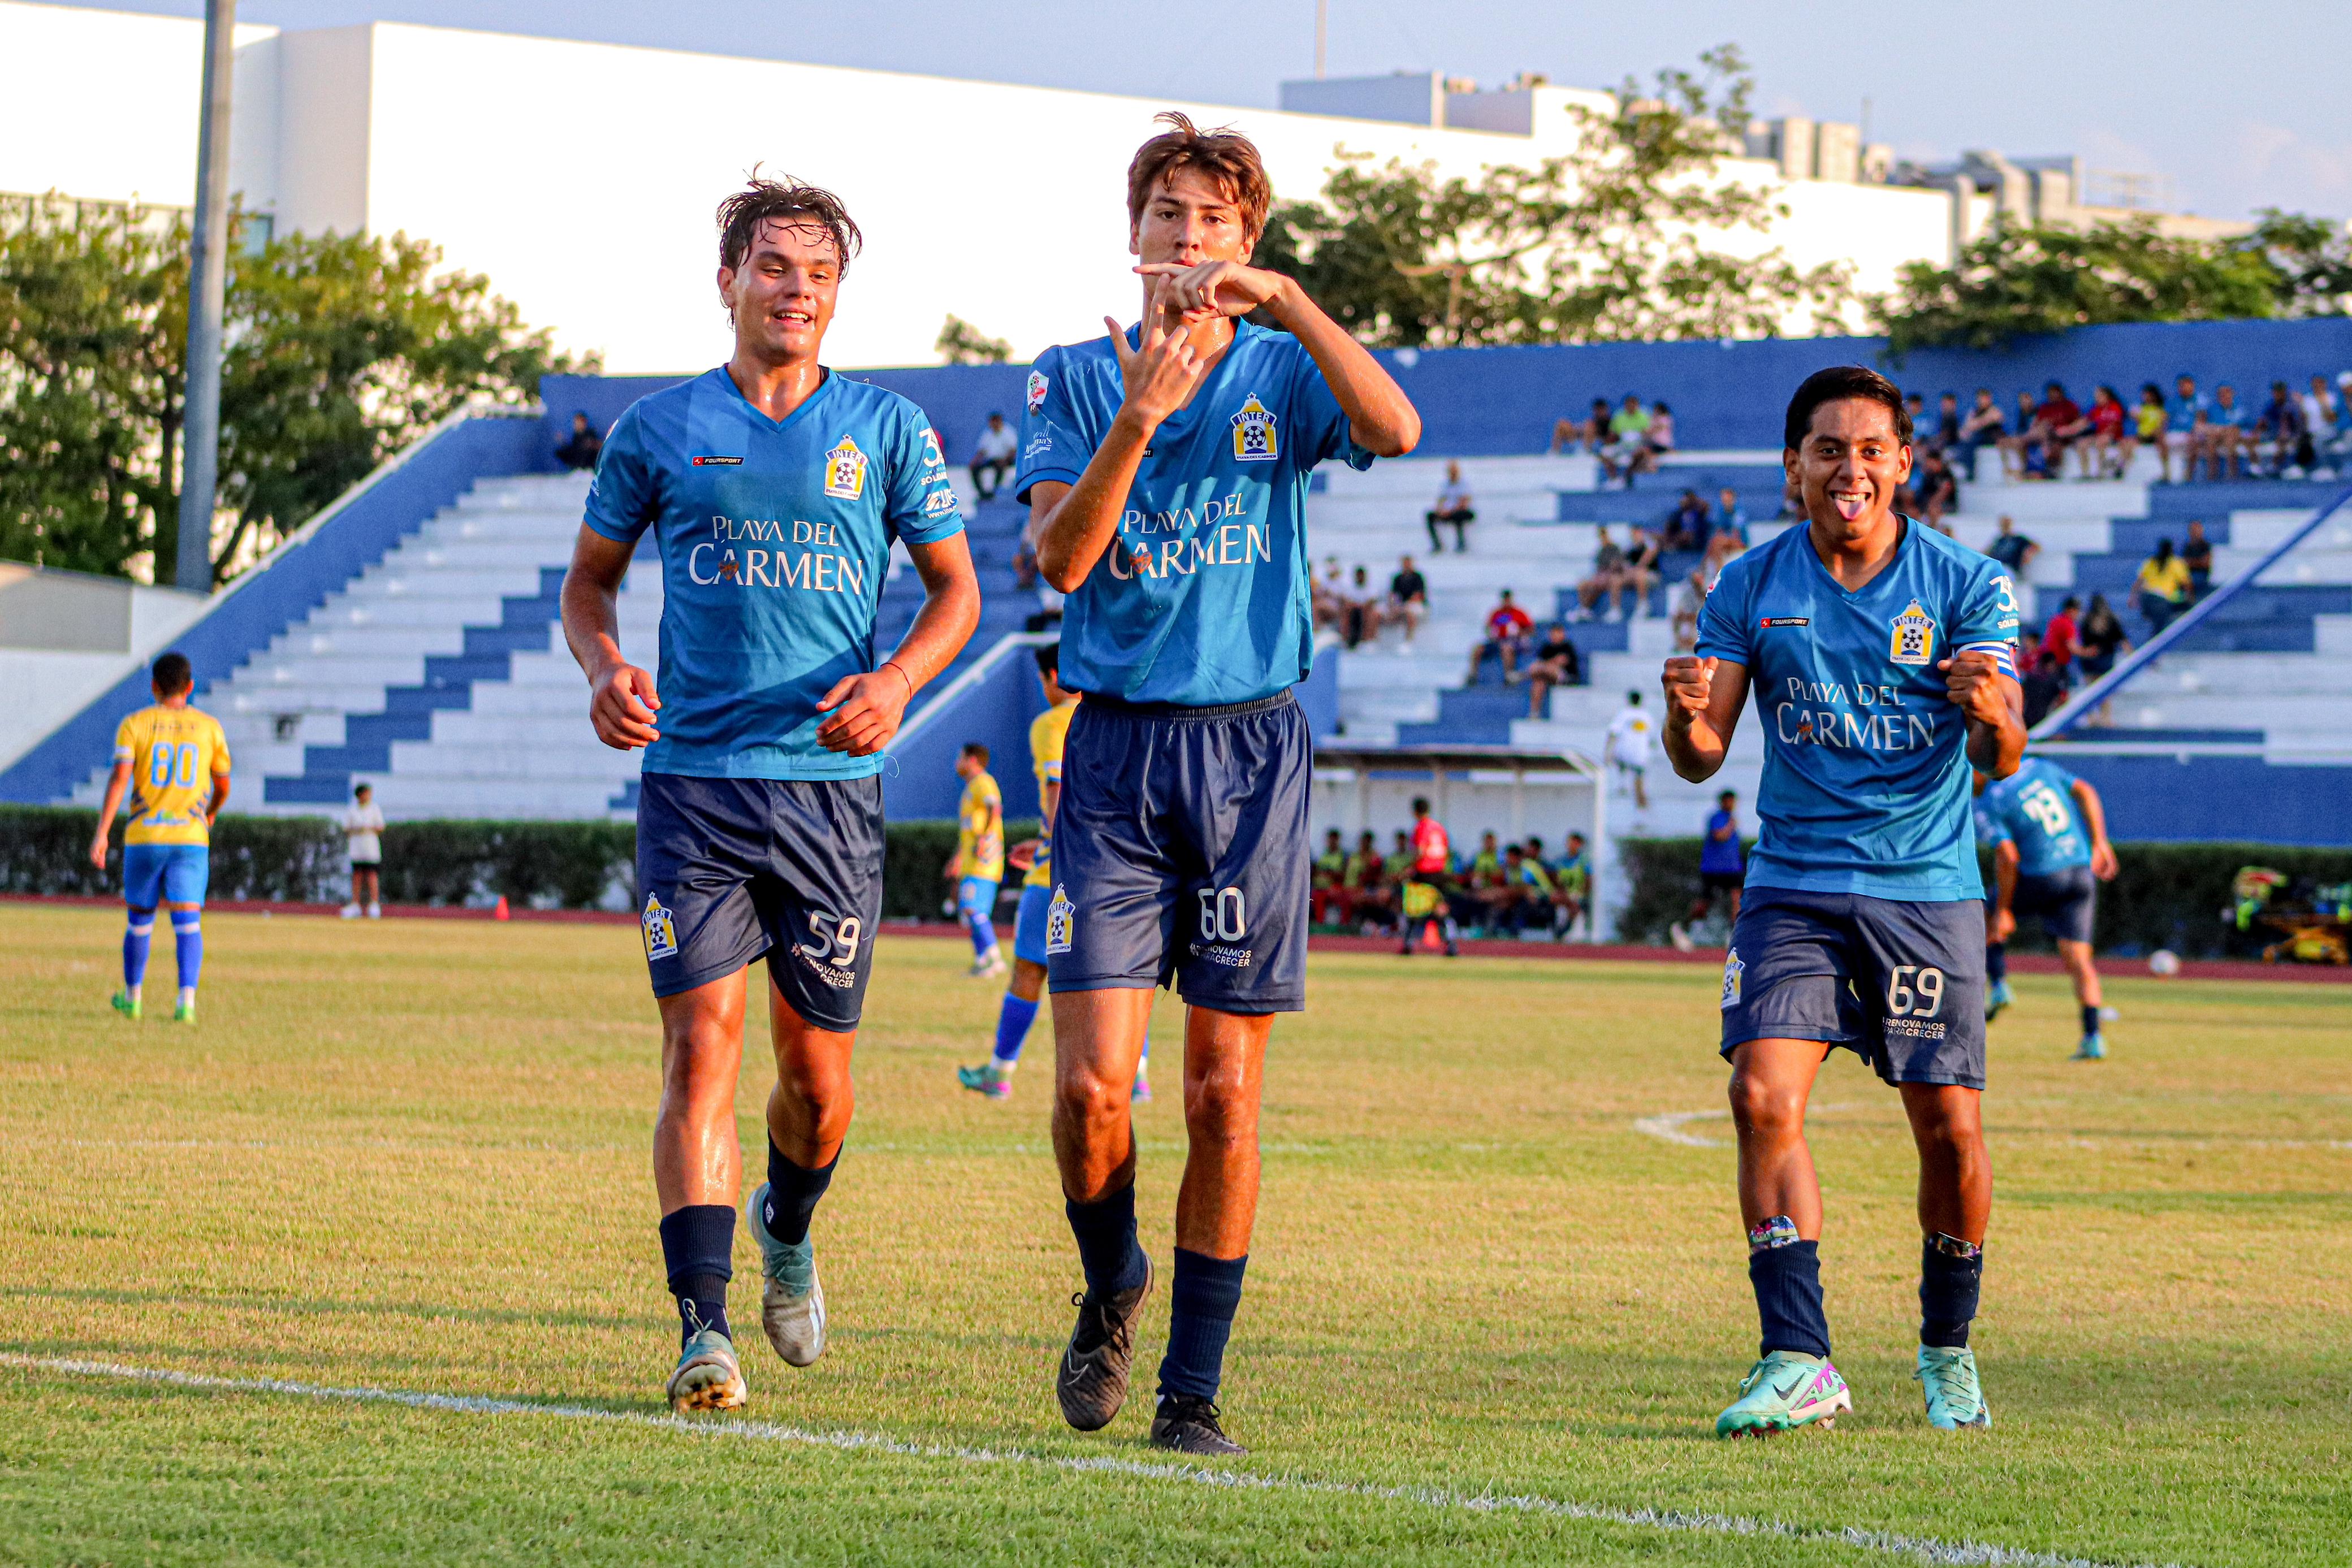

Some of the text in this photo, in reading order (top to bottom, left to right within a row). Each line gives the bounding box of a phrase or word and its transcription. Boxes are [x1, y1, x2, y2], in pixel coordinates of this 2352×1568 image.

[1237, 412, 1270, 423] INTER
[832, 450, 862, 464] INTER
[712, 516, 840, 546] PLAYA DEL
[1124, 492, 1247, 534] PLAYA DEL
[689, 542, 863, 595] CARMEN
[1109, 523, 1271, 581] CARMEN
[1899, 616, 1929, 627] INTER
[1787, 677, 1906, 706] PLAYA DEL
[1777, 701, 1935, 751] CARMEN
[150, 742, 198, 787] 80
[645, 909, 665, 921] INTER
[1050, 902, 1070, 914] INTER
[1197, 886, 1245, 941] 60
[800, 909, 861, 966] 59
[1889, 965, 1943, 1017] 69
